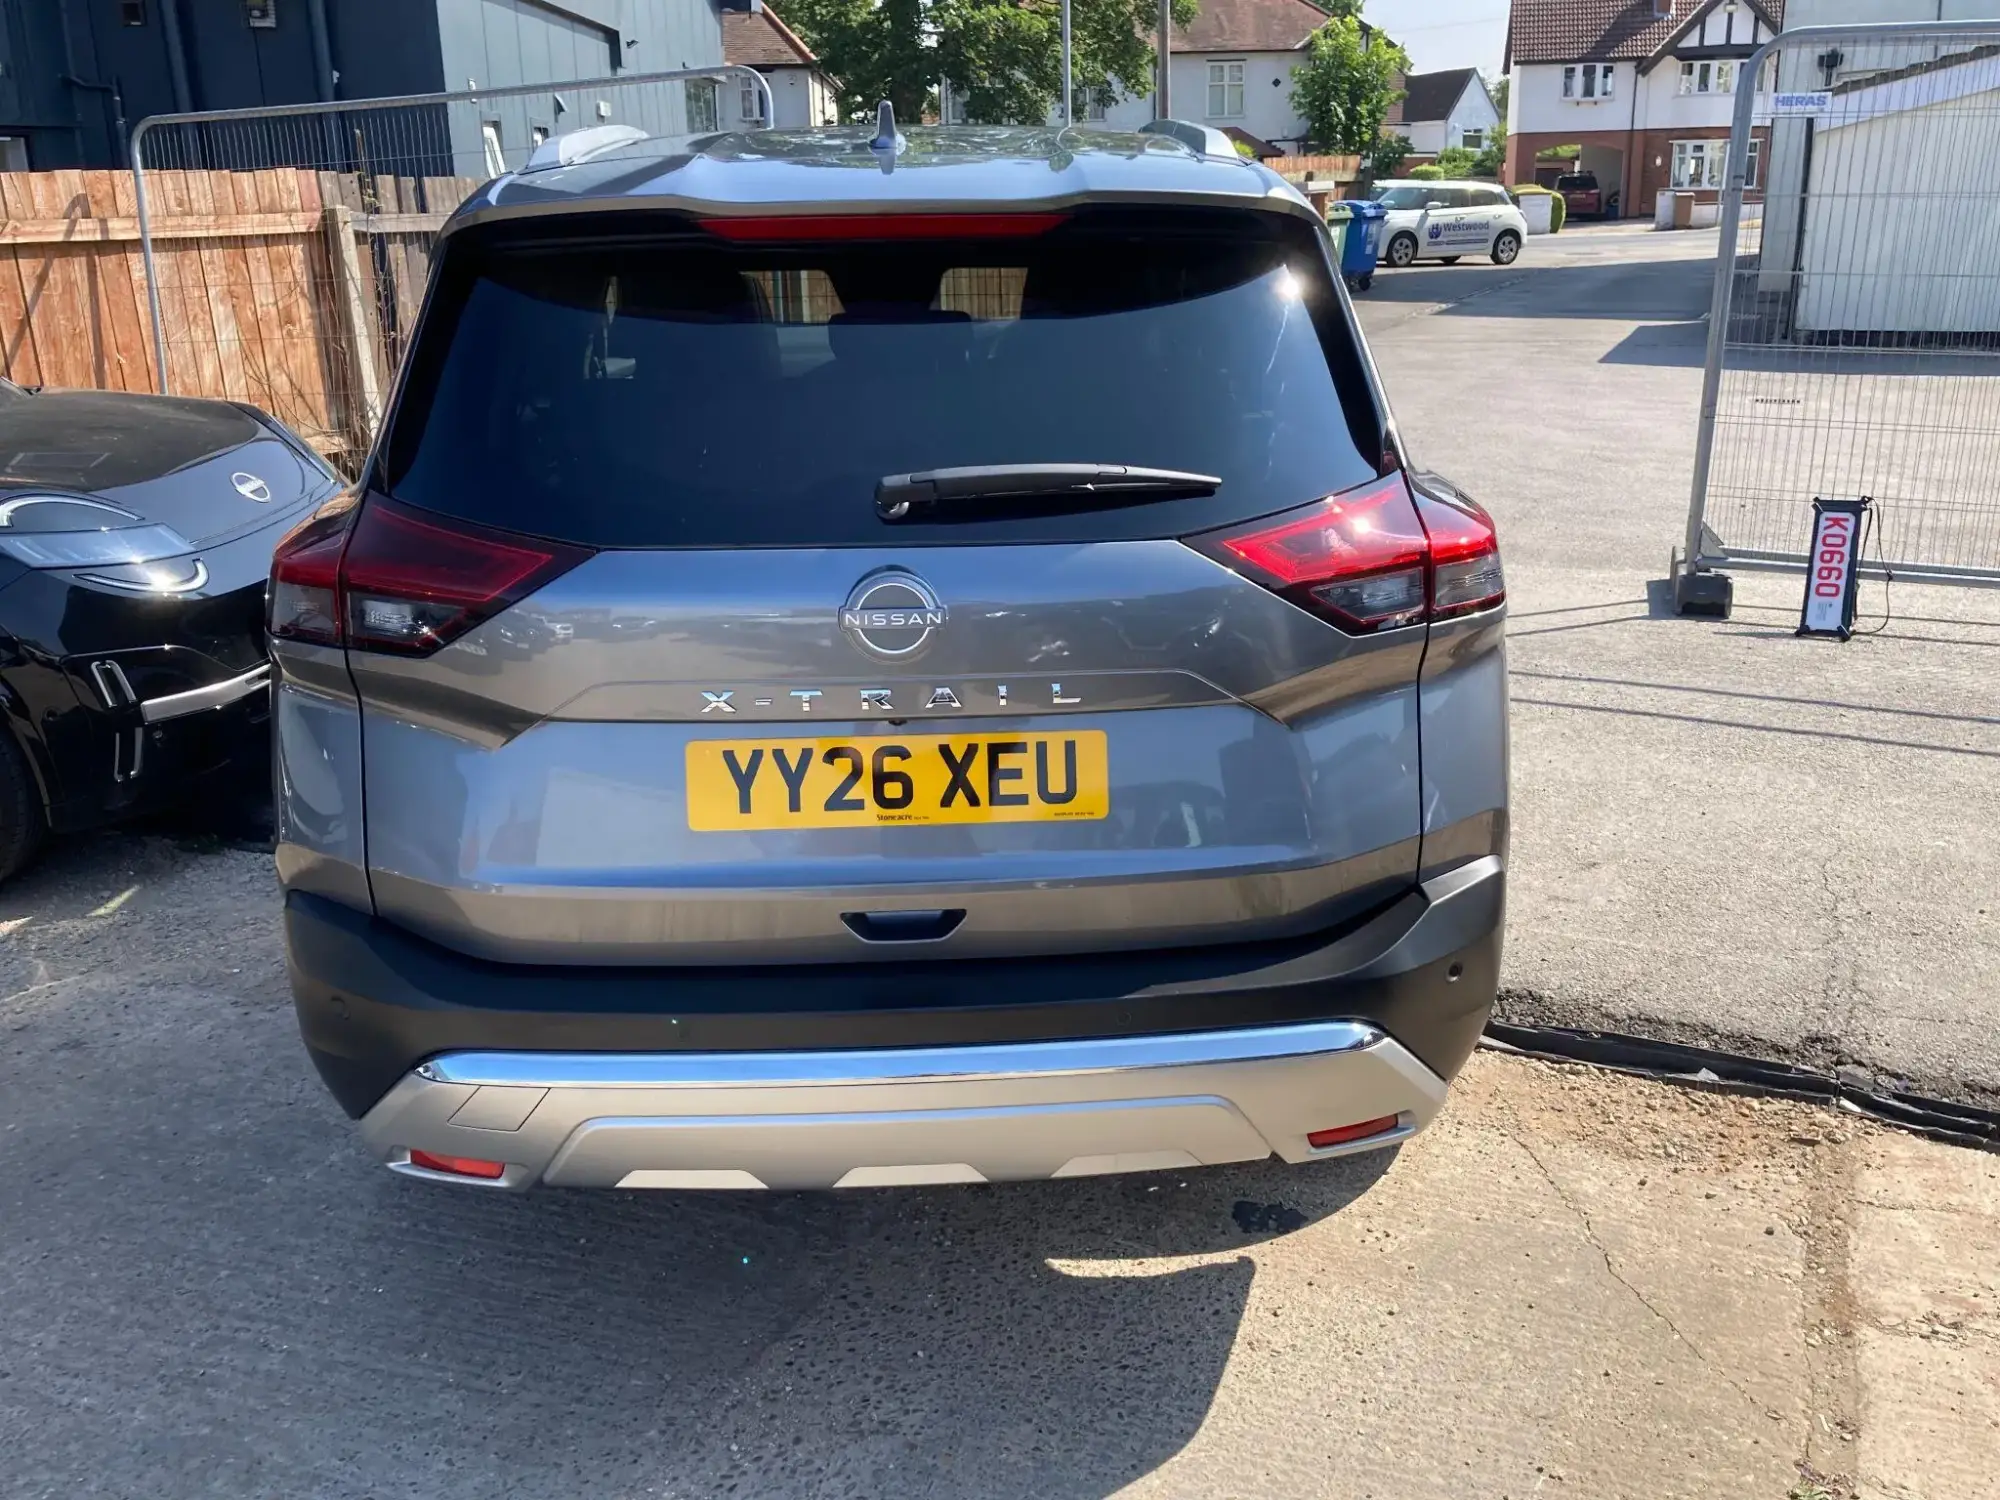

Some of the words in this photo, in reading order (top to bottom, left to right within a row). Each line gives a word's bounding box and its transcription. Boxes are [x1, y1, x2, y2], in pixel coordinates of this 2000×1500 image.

[1774, 95, 1828, 107] HERAS
[1443, 220, 1490, 232] Westwood
[1814, 516, 1850, 598] K0660
[845, 612, 942, 626] NISSAN
[700, 682, 1082, 714] X-TRAIL
[722, 744, 914, 815] YY26
[937, 739, 1079, 810] XEU
